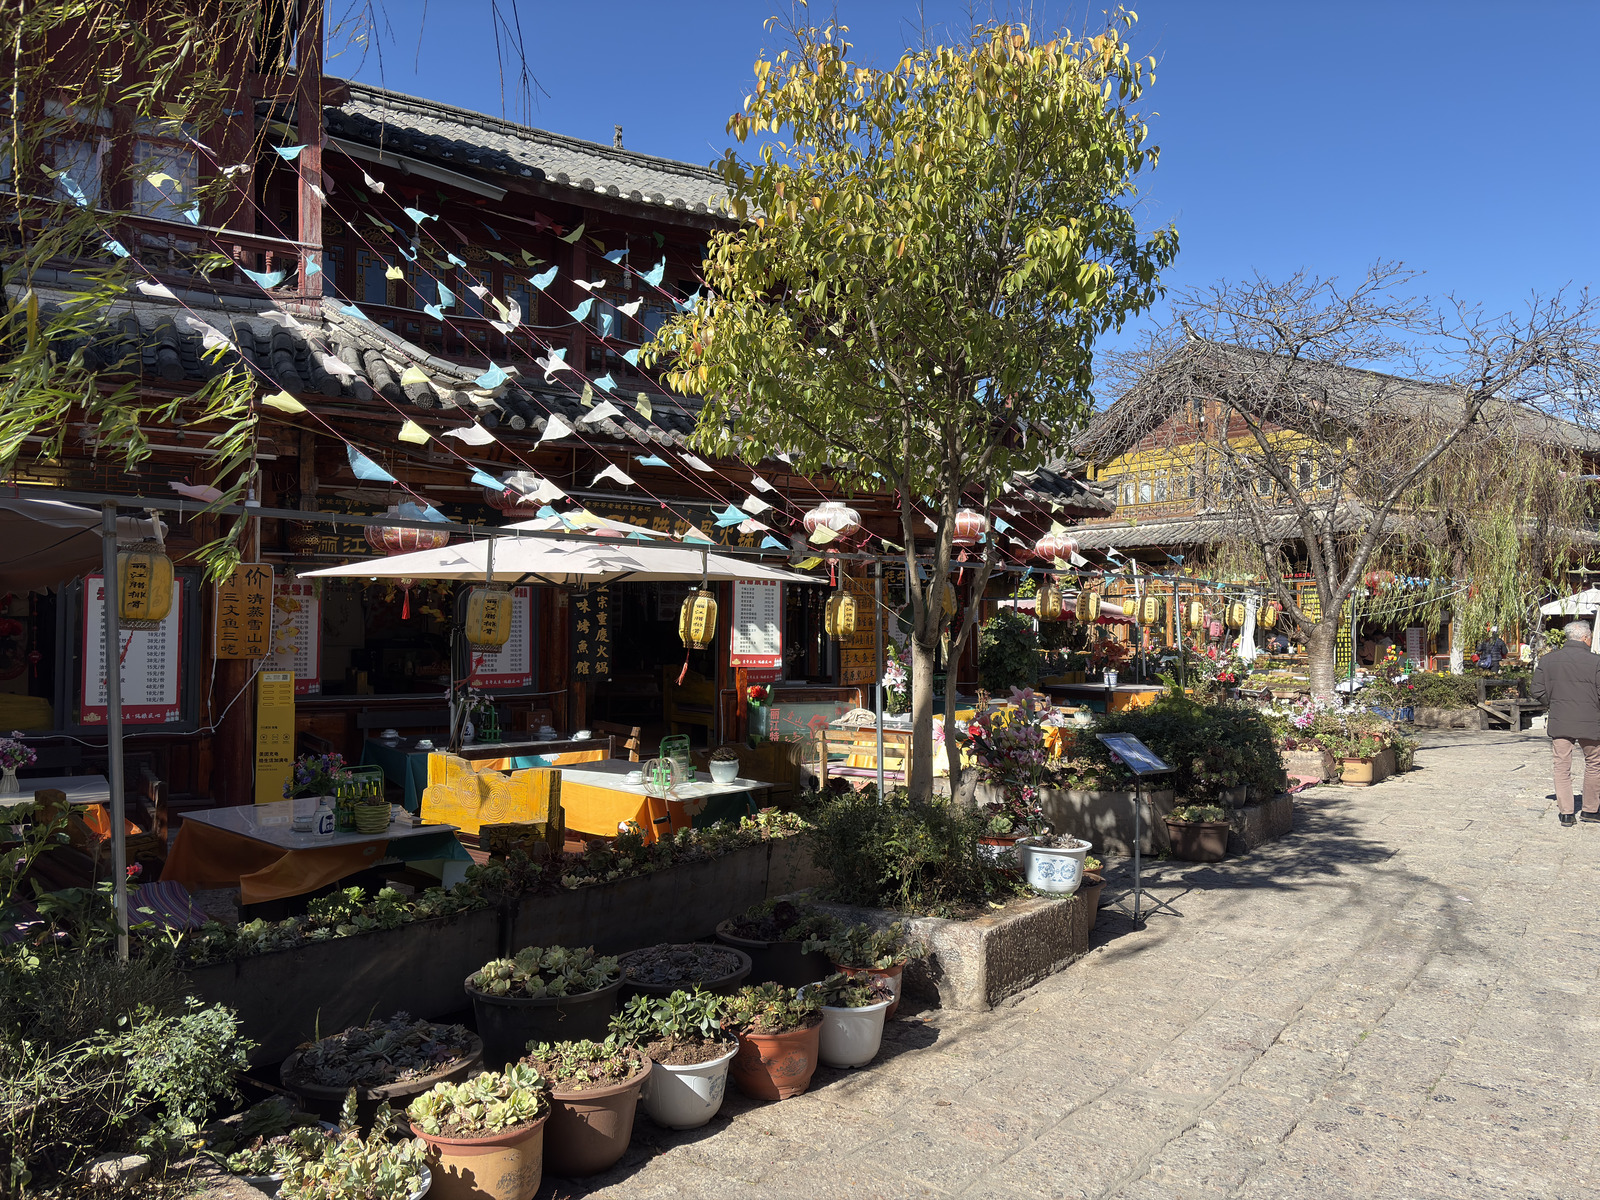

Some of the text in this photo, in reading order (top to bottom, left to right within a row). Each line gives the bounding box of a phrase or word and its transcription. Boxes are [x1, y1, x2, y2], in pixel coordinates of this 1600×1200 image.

[221, 592, 240, 656] 三文鱼三吃
[246, 593, 265, 656] 清蒸雪山鱼
[770, 708, 780, 742] 丽江特
